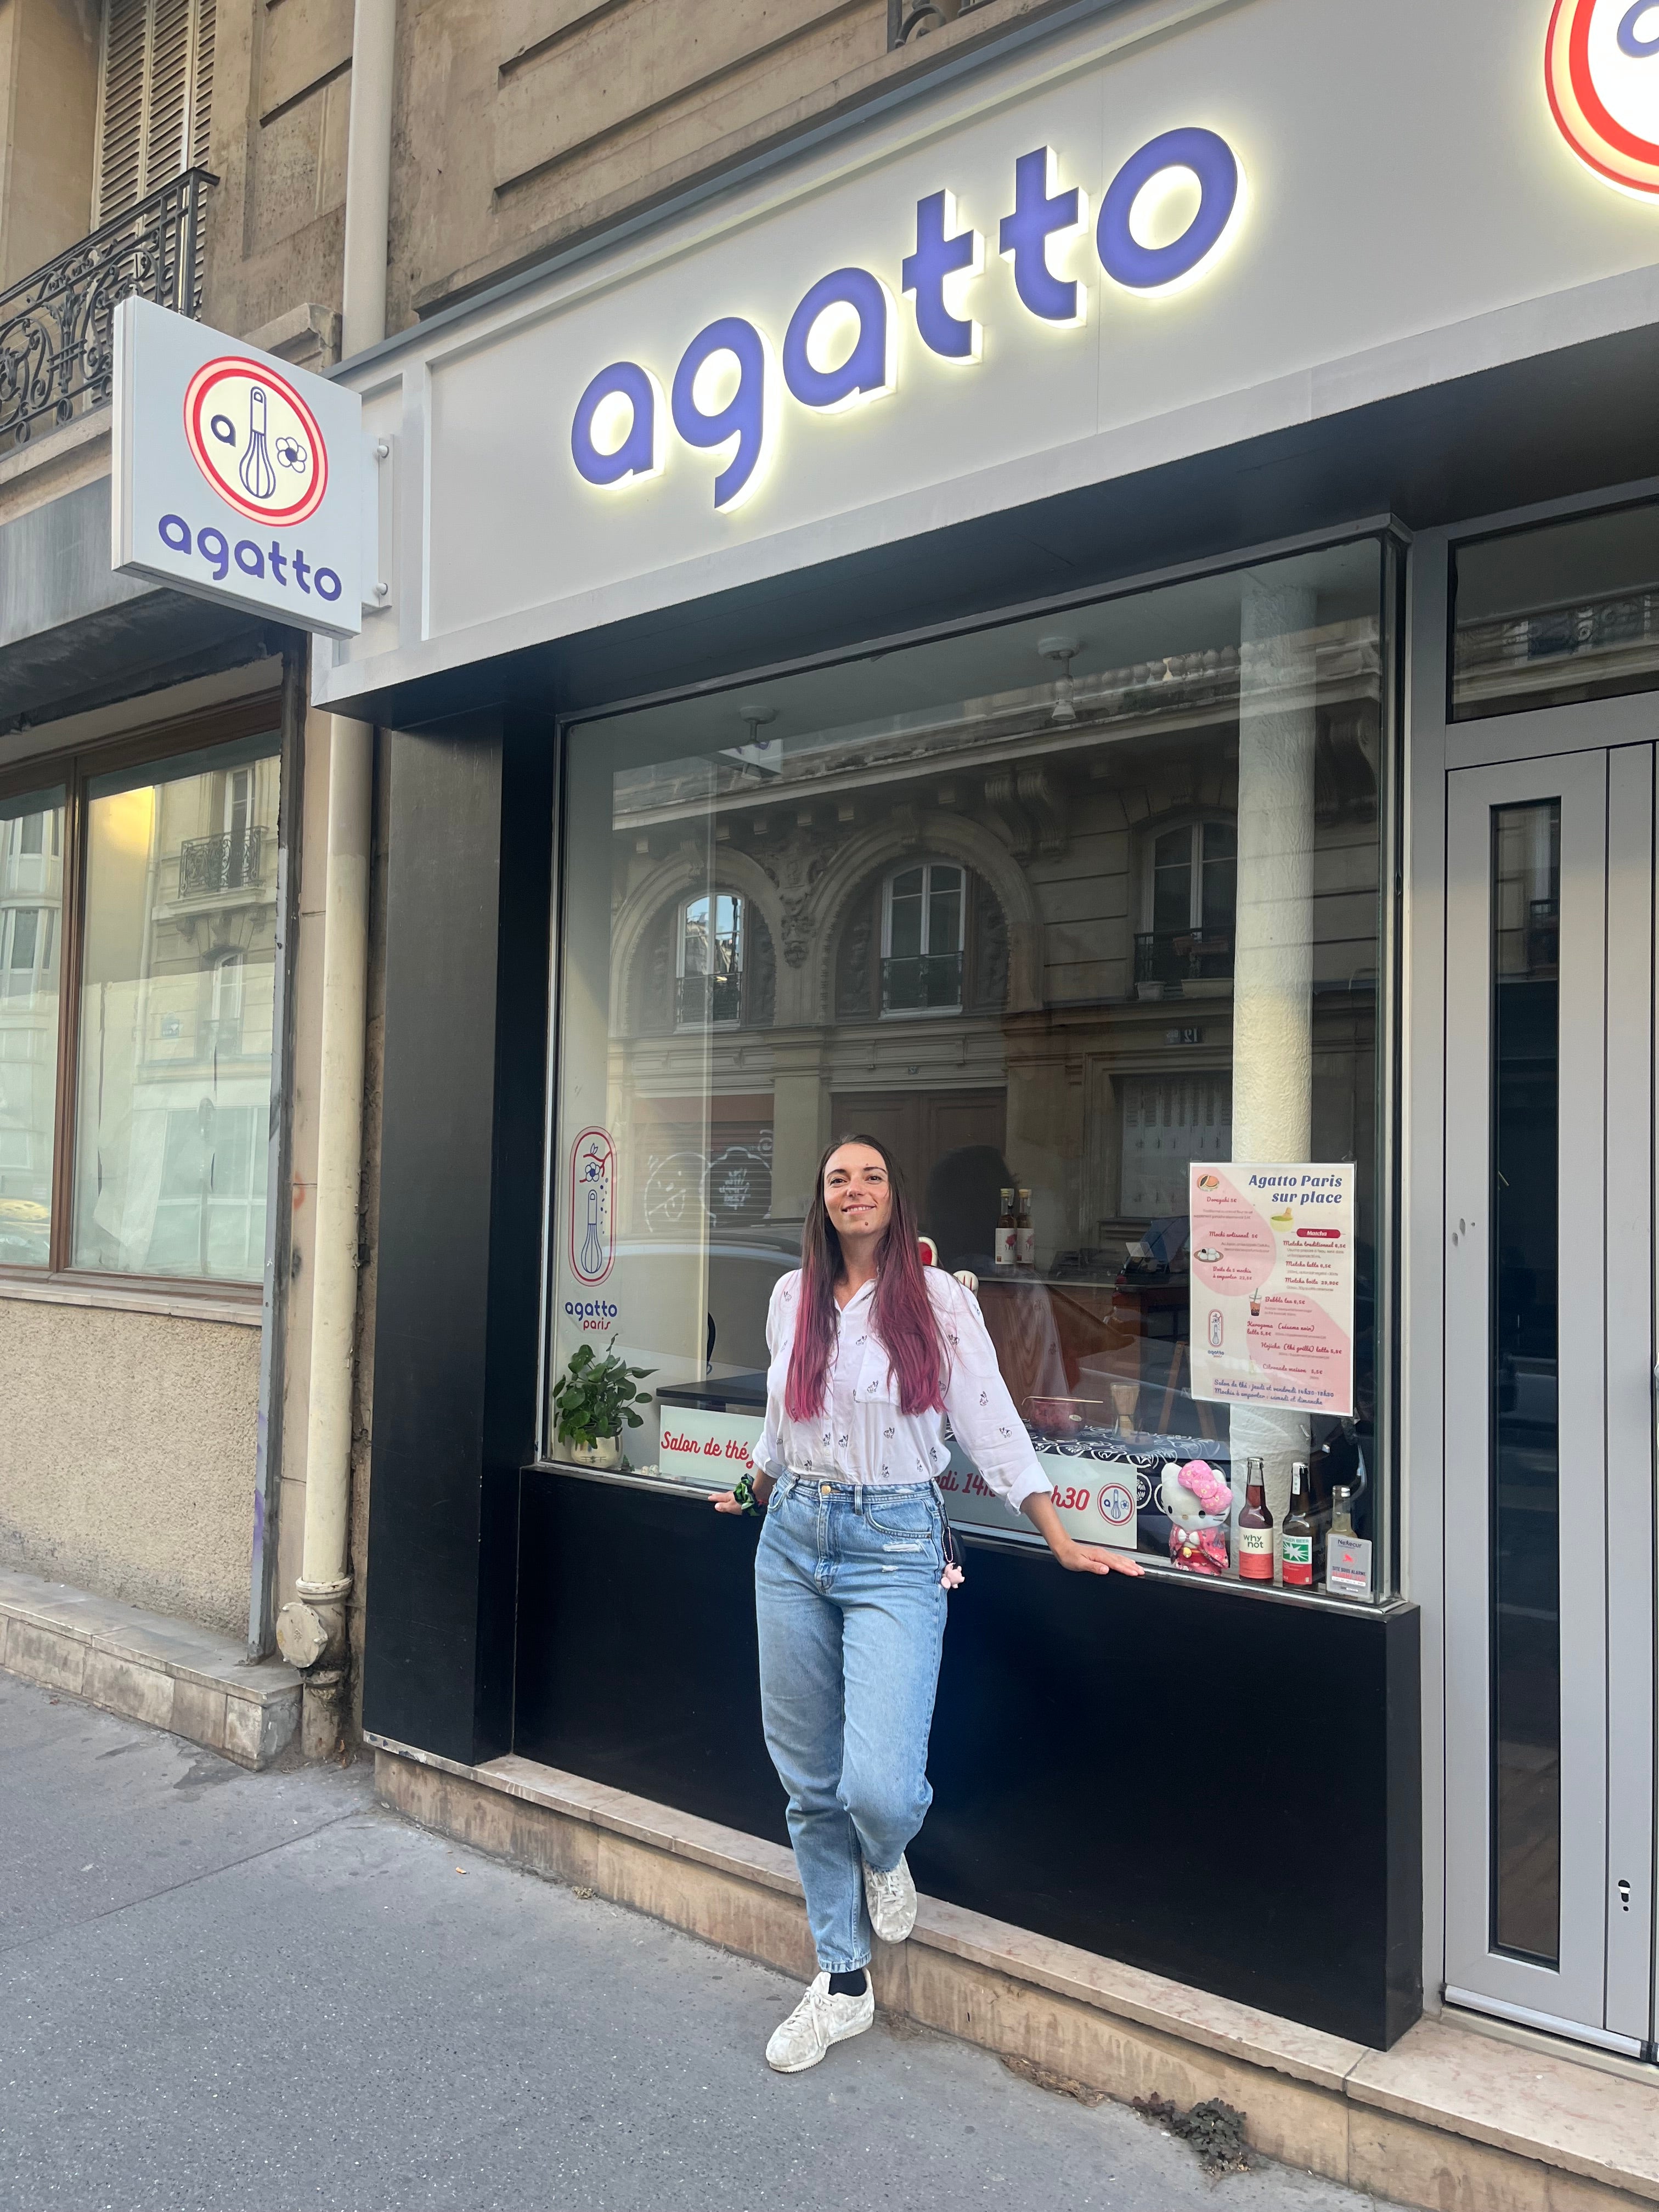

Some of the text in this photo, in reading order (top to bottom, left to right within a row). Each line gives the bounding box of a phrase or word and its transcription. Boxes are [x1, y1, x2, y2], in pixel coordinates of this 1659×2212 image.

[571, 126, 1238, 510] agatto
[158, 514, 342, 601] agatto
[1249, 1175, 1342, 1188] Agatto Paris
[1272, 1191, 1342, 1205] sur place
[565, 1300, 617, 1321] agatto
[583, 1317, 611, 1330] paris
[1247, 1321, 1273, 1329] Kurogoma
[1297, 1396, 1323, 1404] dimanche
[661, 1431, 701, 1453] Salon
[704, 1437, 722, 1456] de
[725, 1440, 749, 1460] thé
